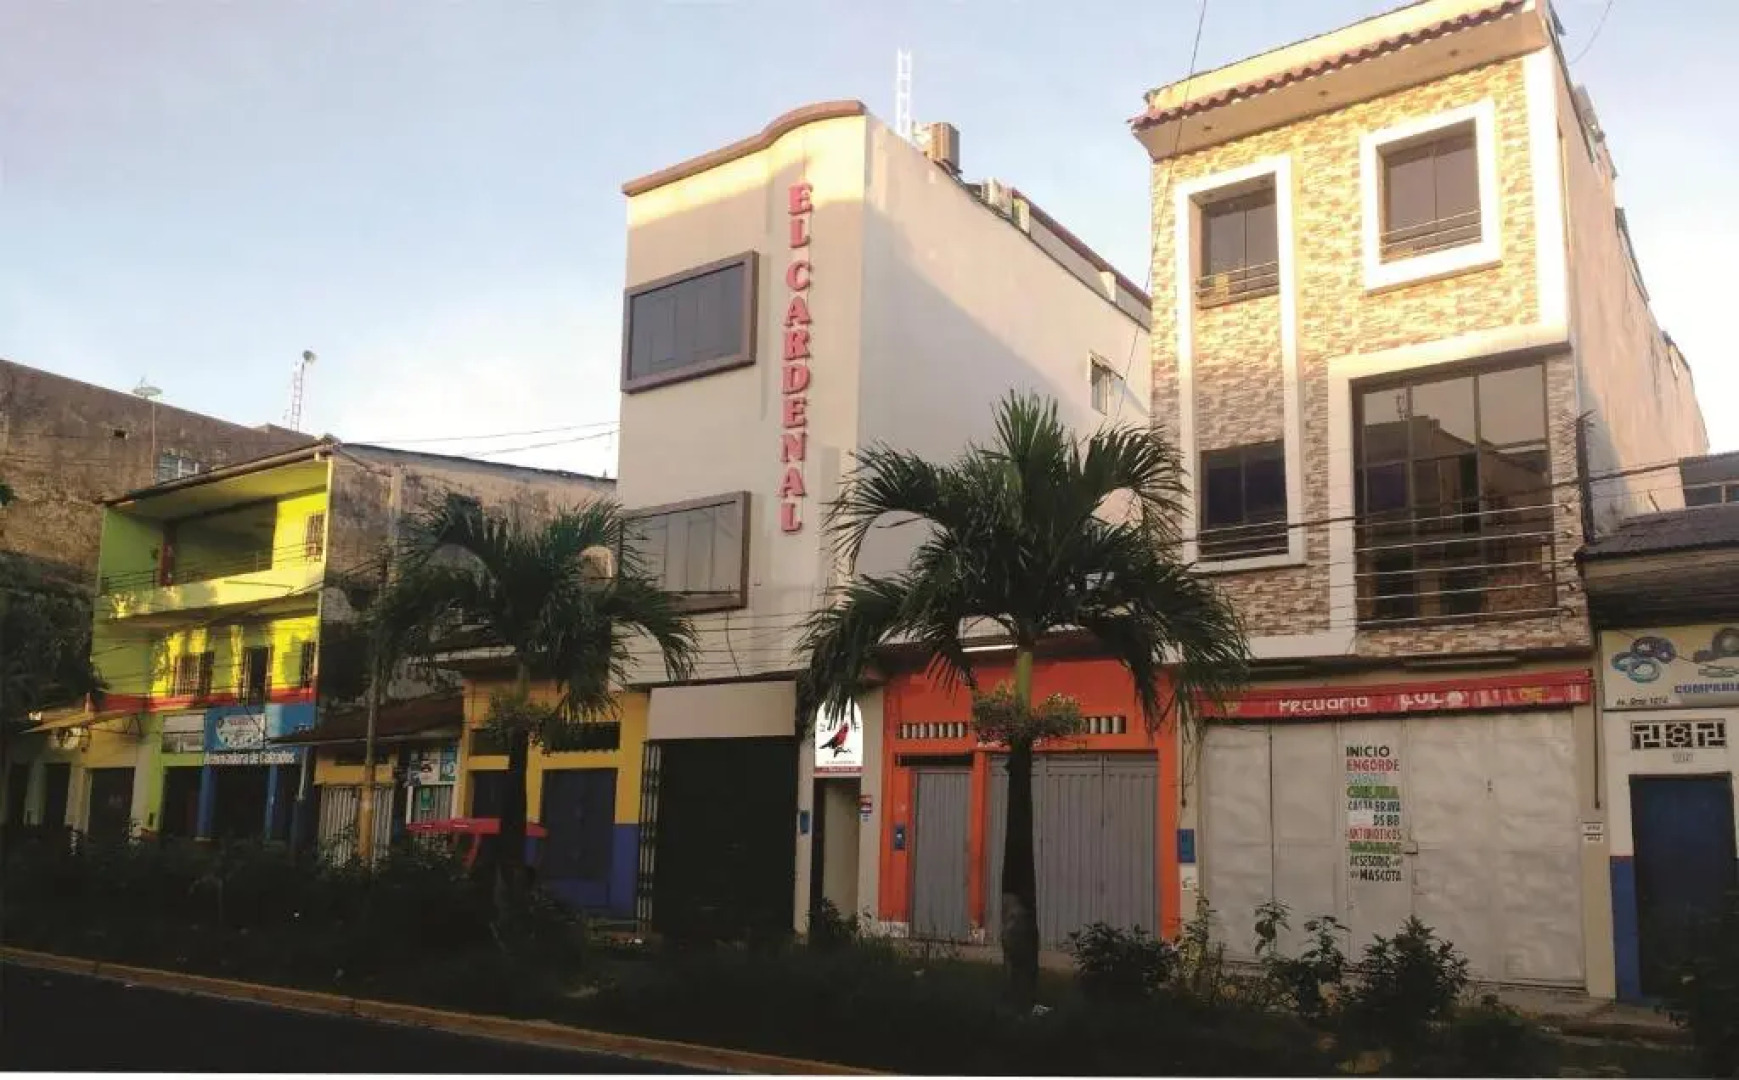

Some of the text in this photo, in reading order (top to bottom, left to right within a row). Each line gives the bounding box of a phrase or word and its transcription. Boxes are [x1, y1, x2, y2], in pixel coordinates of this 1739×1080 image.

[778, 183, 813, 532] EL CARDENAL
[1346, 746, 1390, 758] INICIO
[1347, 759, 1400, 772] ENGORDE
[1360, 869, 1402, 881] MASCOTA
